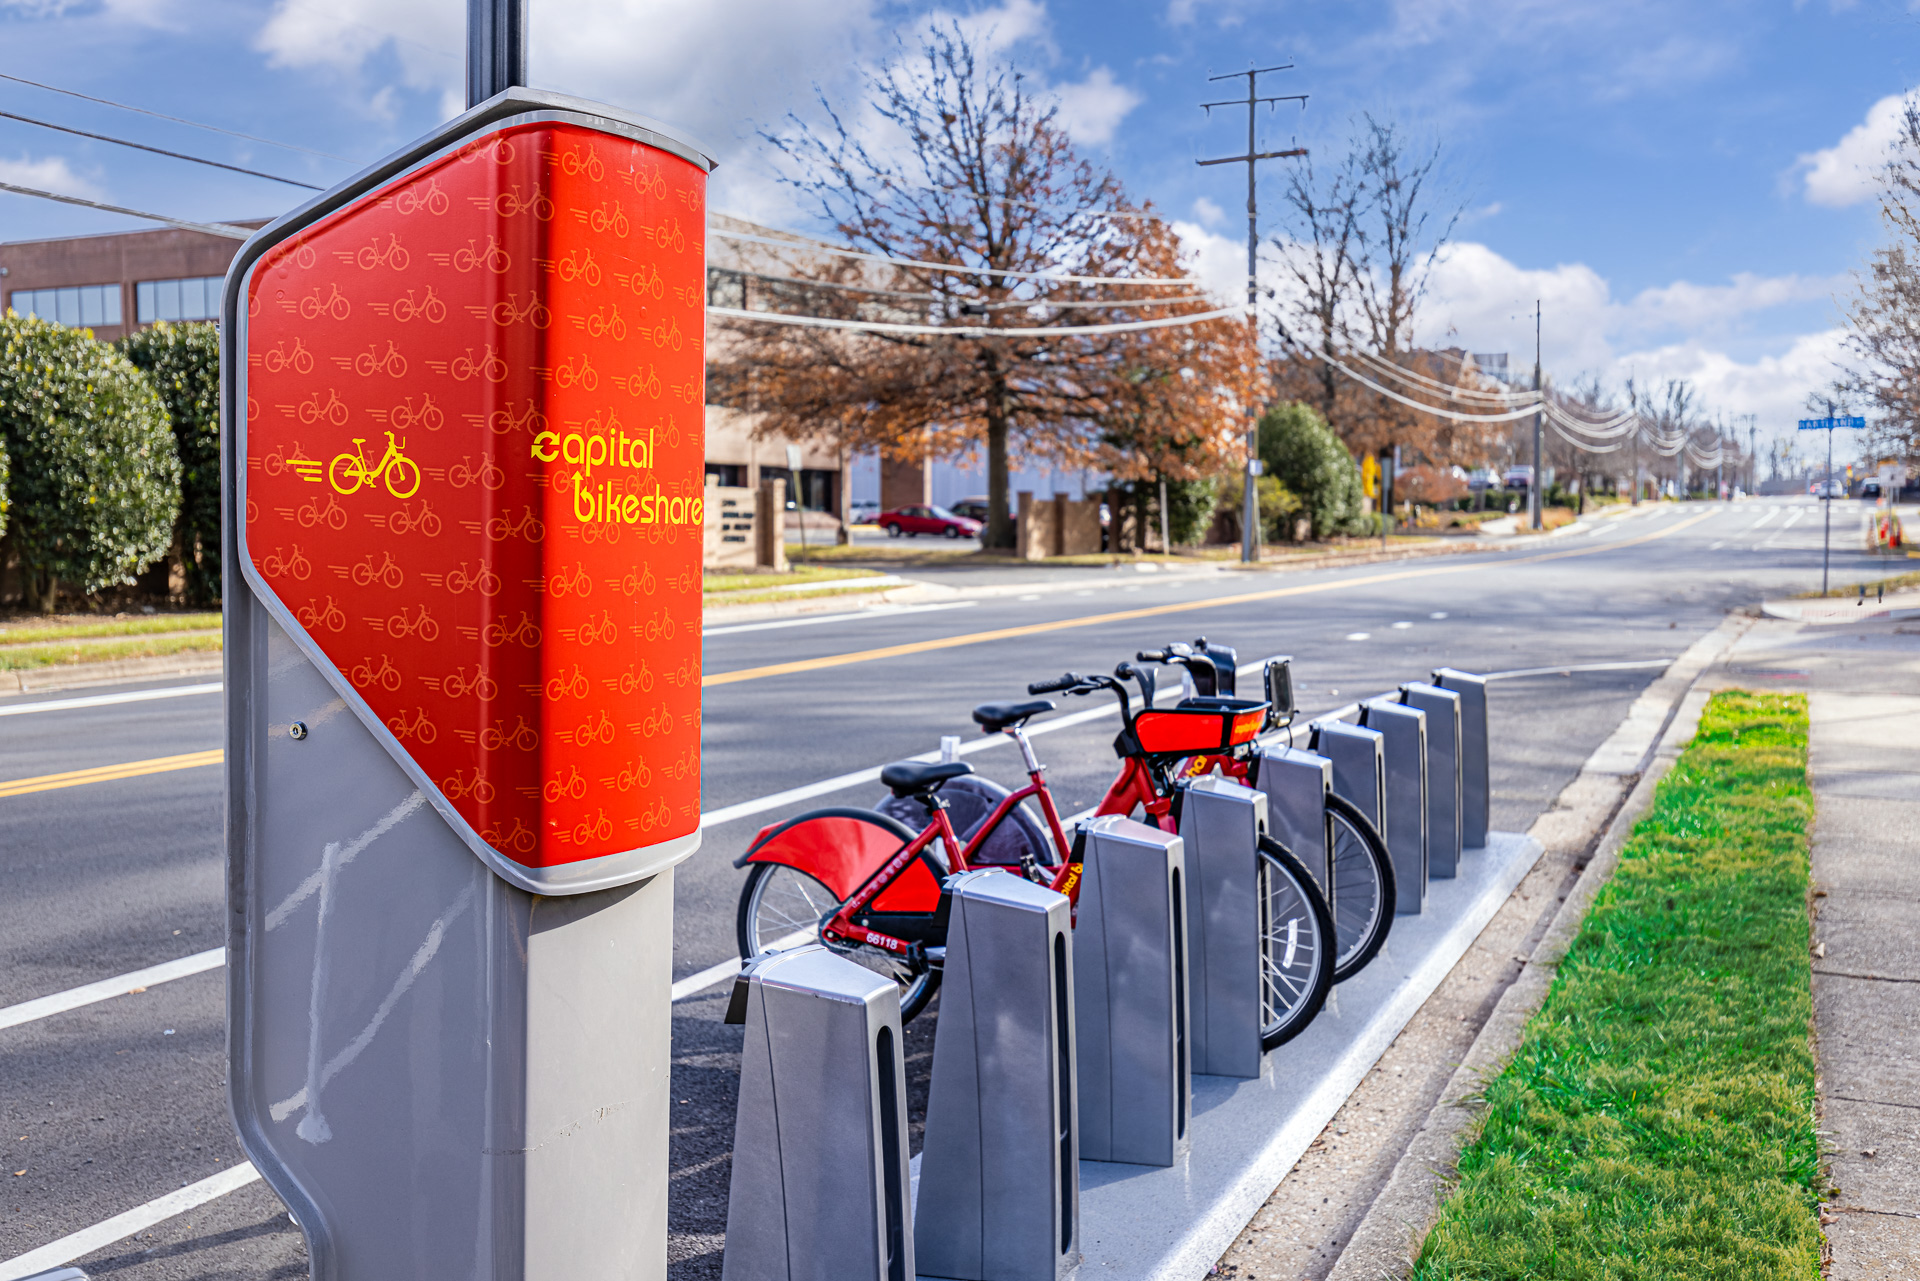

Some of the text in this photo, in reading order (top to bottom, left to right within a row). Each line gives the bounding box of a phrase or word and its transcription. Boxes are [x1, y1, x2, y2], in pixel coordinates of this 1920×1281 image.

[531, 428, 654, 477] capital
[571, 471, 703, 525] bikeshare
[866, 932, 898, 950] 66118
